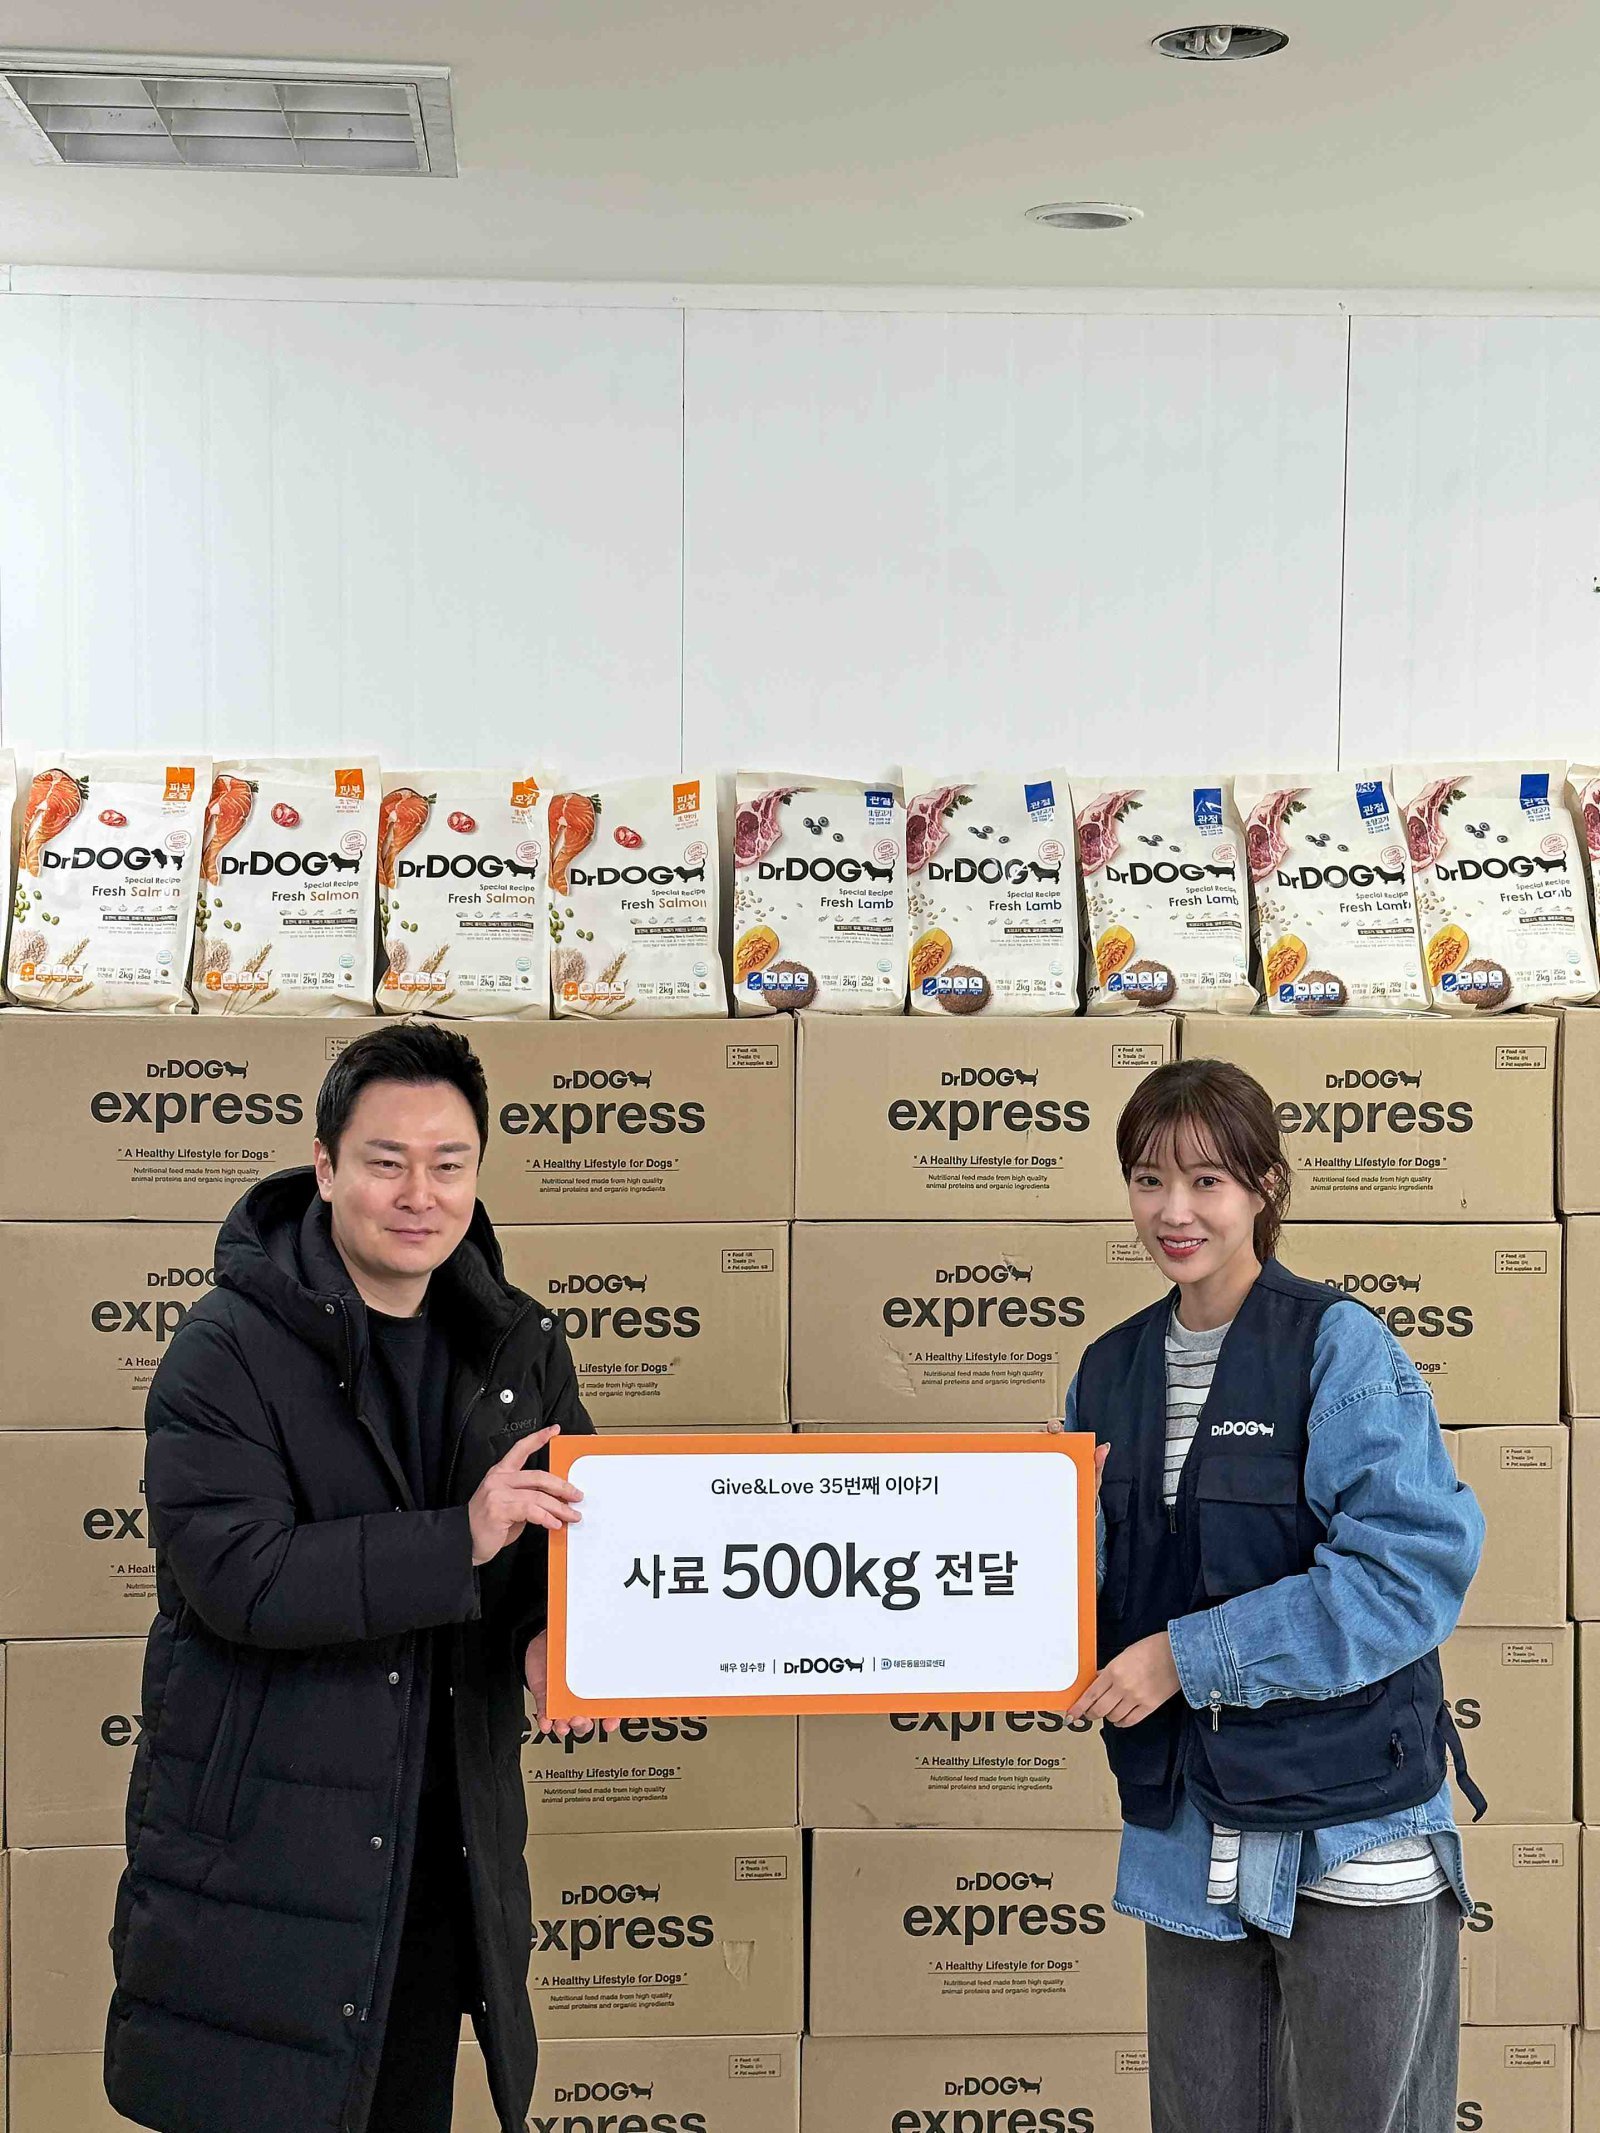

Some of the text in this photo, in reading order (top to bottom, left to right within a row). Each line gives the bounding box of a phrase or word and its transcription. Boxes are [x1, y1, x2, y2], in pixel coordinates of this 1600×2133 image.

[1030, 798, 1051, 809] 관절
[1363, 802, 1385, 815] 관절
[1197, 814, 1218, 824] 관절
[42, 846, 152, 870] DrDOG
[220, 851, 329, 877] DrDOG
[398, 855, 505, 878] DrDOG
[758, 857, 862, 882] DrDOG
[928, 858, 1028, 884] DrDOG
[1435, 855, 1534, 881] DrDOG
[570, 866, 674, 886] DrDOG
[1105, 861, 1205, 885] DrDOG
[1276, 865, 1374, 889] DrDOG
[334, 880, 359, 888] Recipe
[1186, 886, 1213, 894] Special
[1516, 878, 1570, 890] Special Recipe
[92, 886, 126, 896] Fresh
[272, 891, 358, 901] Fresh Salmon
[839, 888, 866, 896] Special
[1007, 891, 1033, 899] Special
[1356, 892, 1408, 900] Special Recipe
[1500, 892, 1534, 902] Fresh
[448, 893, 534, 904] Fresh Salmon
[622, 898, 706, 910] Fresh Salmon
[821, 897, 893, 909] Fresh Lamb
[1169, 895, 1239, 907] Fresh Lamb
[990, 899, 1062, 911] Fresh Lamb
[1340, 900, 1411, 912] Fresh Lamb
[119, 972, 133, 981] 2kg
[303, 976, 317, 985] 2kg
[843, 978, 857, 987] 2kg
[1201, 977, 1215, 985] 2kg
[1536, 973, 1550, 982] 2kg
[480, 979, 494, 988] 2kg
[1016, 983, 1030, 992] 2kg
[659, 986, 673, 994] 2kg
[1372, 987, 1385, 995] 2kg
[147, 1060, 224, 1079] DrDOG
[553, 1070, 628, 1089] DrDOG
[941, 1068, 1014, 1086] DrDOG
[1325, 1069, 1398, 1089] DrDOG
[90, 1091, 303, 1133] express
[499, 1101, 706, 1144] express
[888, 1098, 1090, 1140] express
[1274, 1100, 1473, 1143] express
[125, 1149, 268, 1159] A Healthy Lifestyle for Dogs
[532, 1159, 672, 1169] A Healthy Lifestyle for Dogs
[920, 1156, 1056, 1166] A Healthy Lifestyle for Dogs
[936, 1265, 1009, 1283] DrDOG
[548, 1274, 623, 1294] DrDOG
[883, 1295, 1085, 1337] express
[1211, 1421, 1258, 1436] DrDOG
[711, 1476, 938, 1495] Give&Love 35번째 이야기
[624, 1542, 1018, 1611] 사료 500kg 전달
[720, 1662, 738, 1672] 배우
[784, 1658, 844, 1674] DrDOG
[922, 1757, 1059, 1767] A Healthy Lifestyle for Dogs
[535, 1767, 674, 1778] A Healthy Lifestyle for Dogs
[957, 1872, 1029, 1891] DrDOG
[561, 1884, 636, 1905] DrDOG
[903, 1903, 1106, 1945] express
[529, 1914, 714, 1960] xpress
[935, 1960, 1072, 1970] A Healthy Lifestyle for Dogs
[554, 2082, 630, 2102] DrDOG
[945, 2077, 1018, 2095] DrDOG
[524, 2113, 707, 2133] xpress
[891, 2106, 1094, 2133] express
